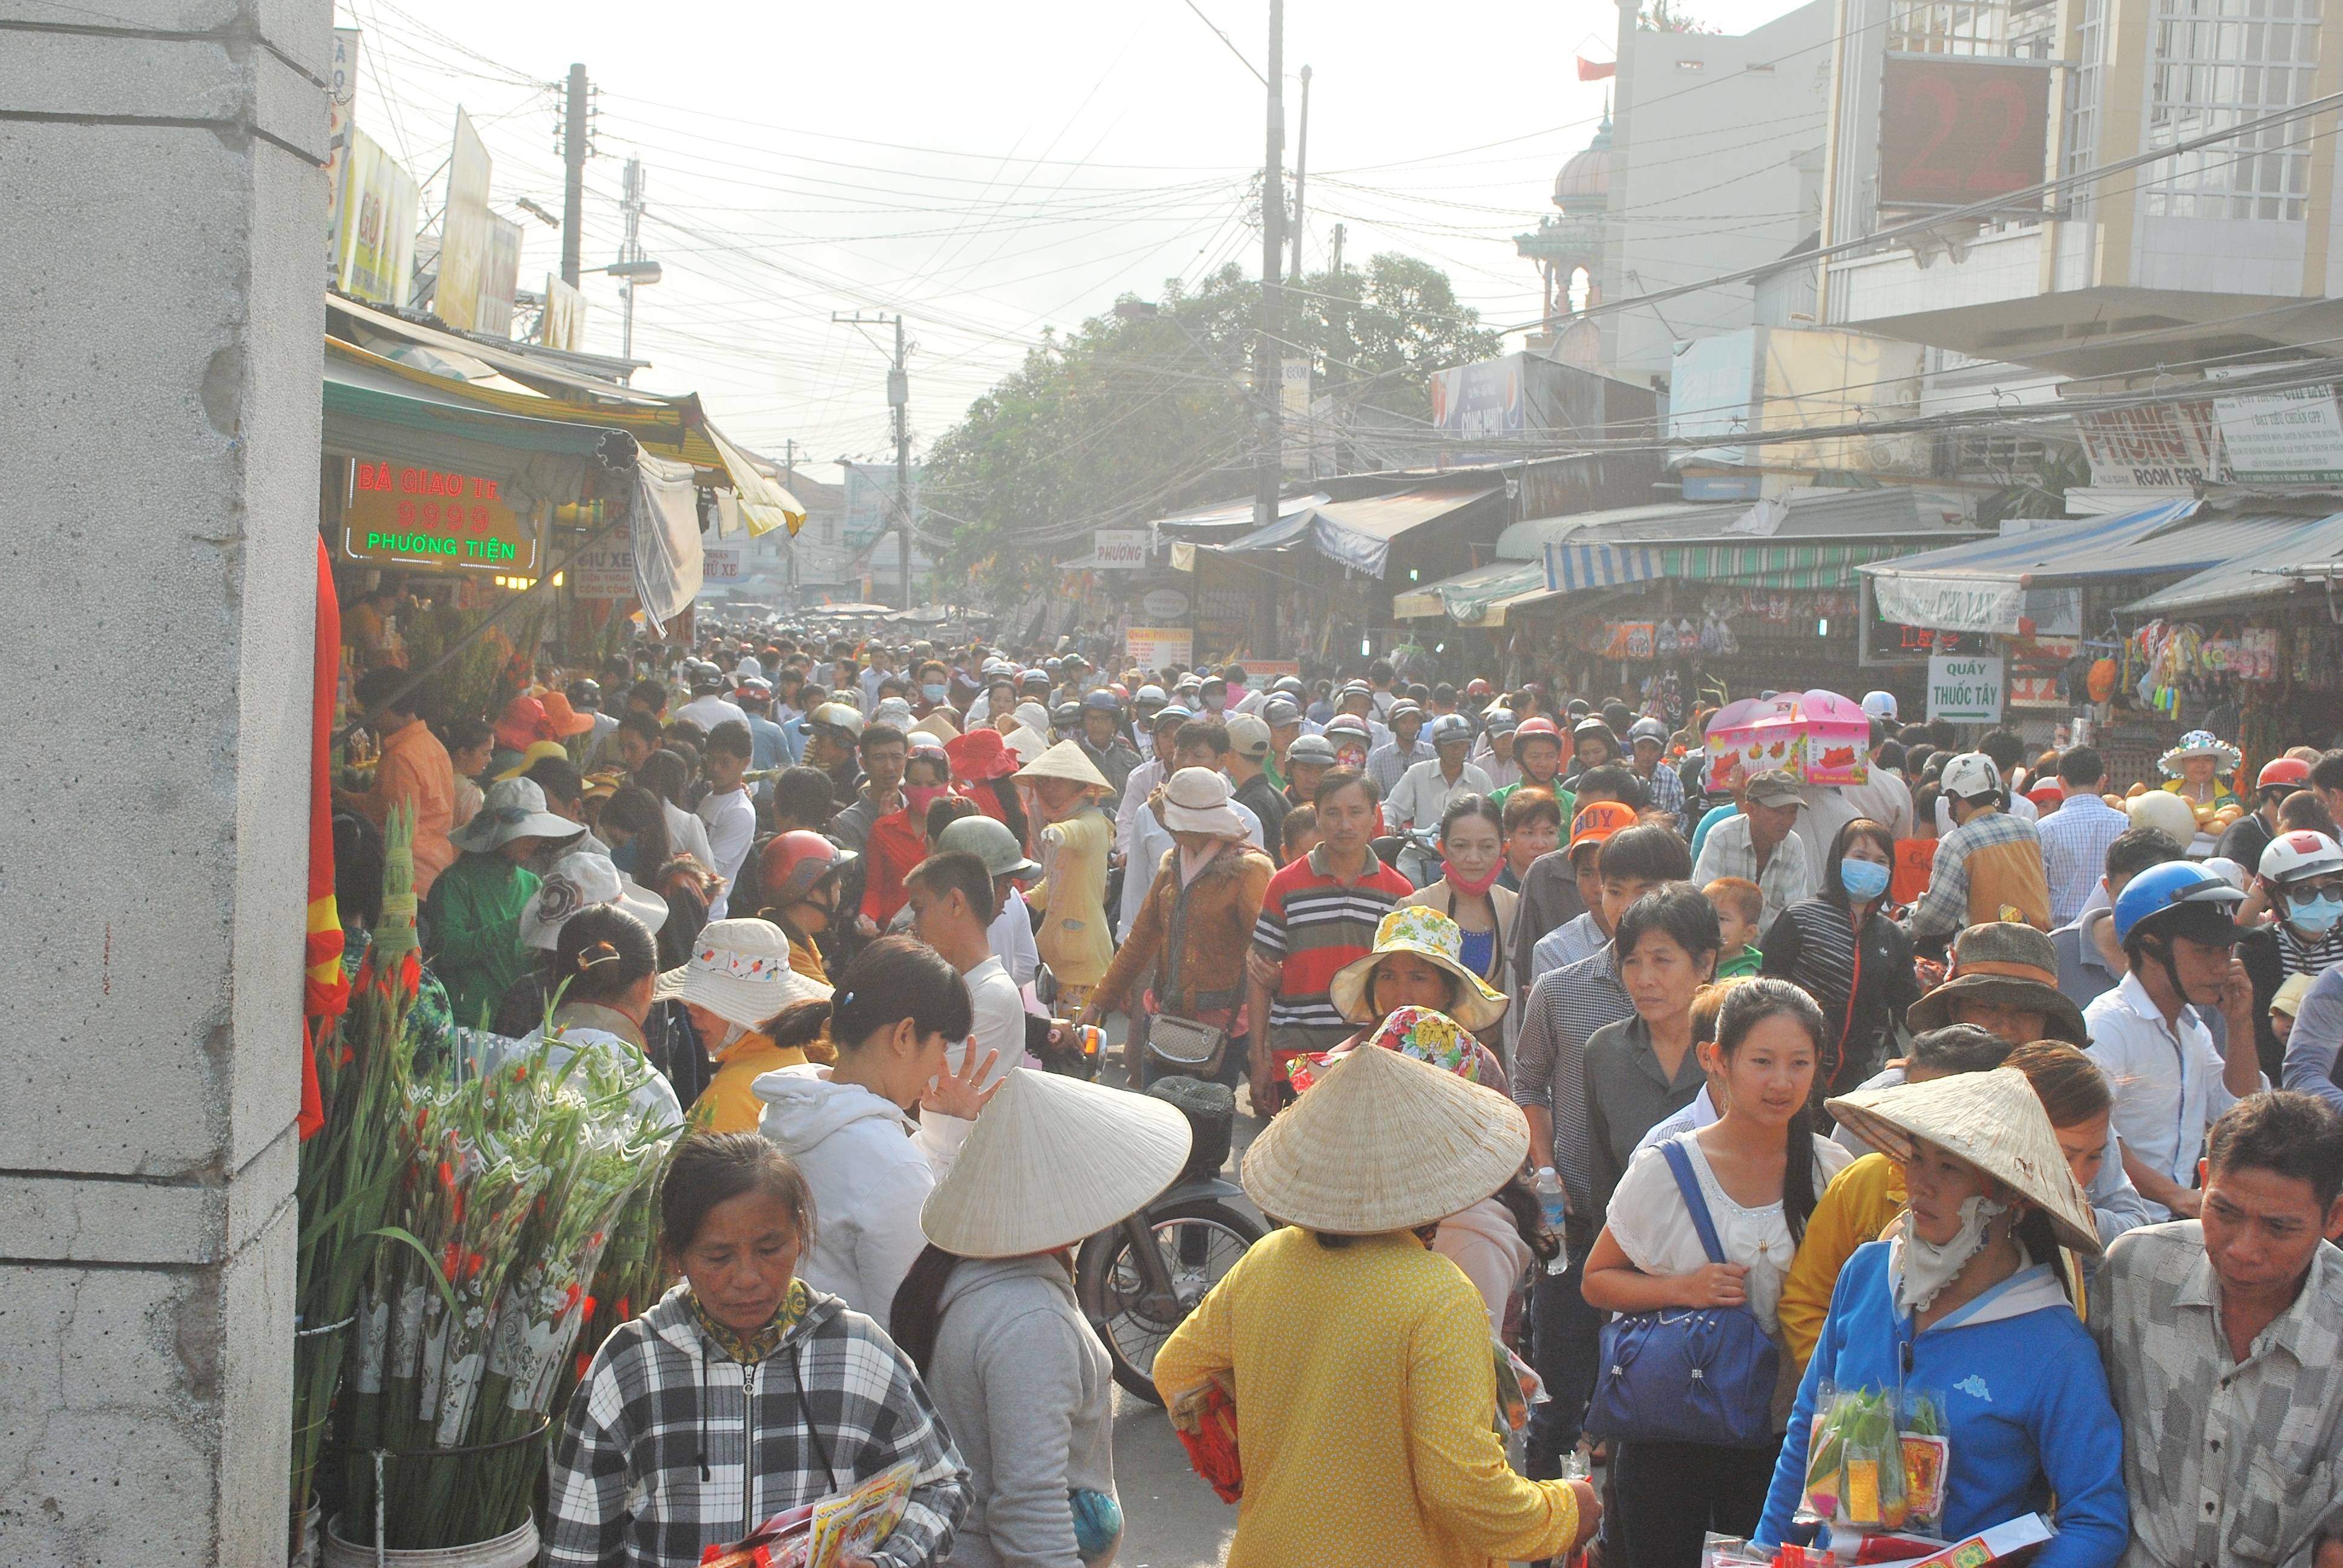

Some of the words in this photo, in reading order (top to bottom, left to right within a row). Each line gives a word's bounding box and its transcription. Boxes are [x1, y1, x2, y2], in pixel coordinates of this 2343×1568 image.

[1901, 75, 2029, 191] 22
[1461, 403, 1482, 440] CÔNG
[2133, 467, 2174, 486] ROOM
[2174, 466, 2203, 485] FOR
[397, 500, 490, 534] 9999
[367, 532, 457, 555] PHƯƠNG
[465, 536, 516, 563] TIỆN
[611, 552, 632, 567] XE
[722, 563, 737, 576] XE
[1933, 679, 1972, 706] THUỐC
[1974, 682, 1997, 706] TÂY
[1574, 808, 1616, 836] BOY
